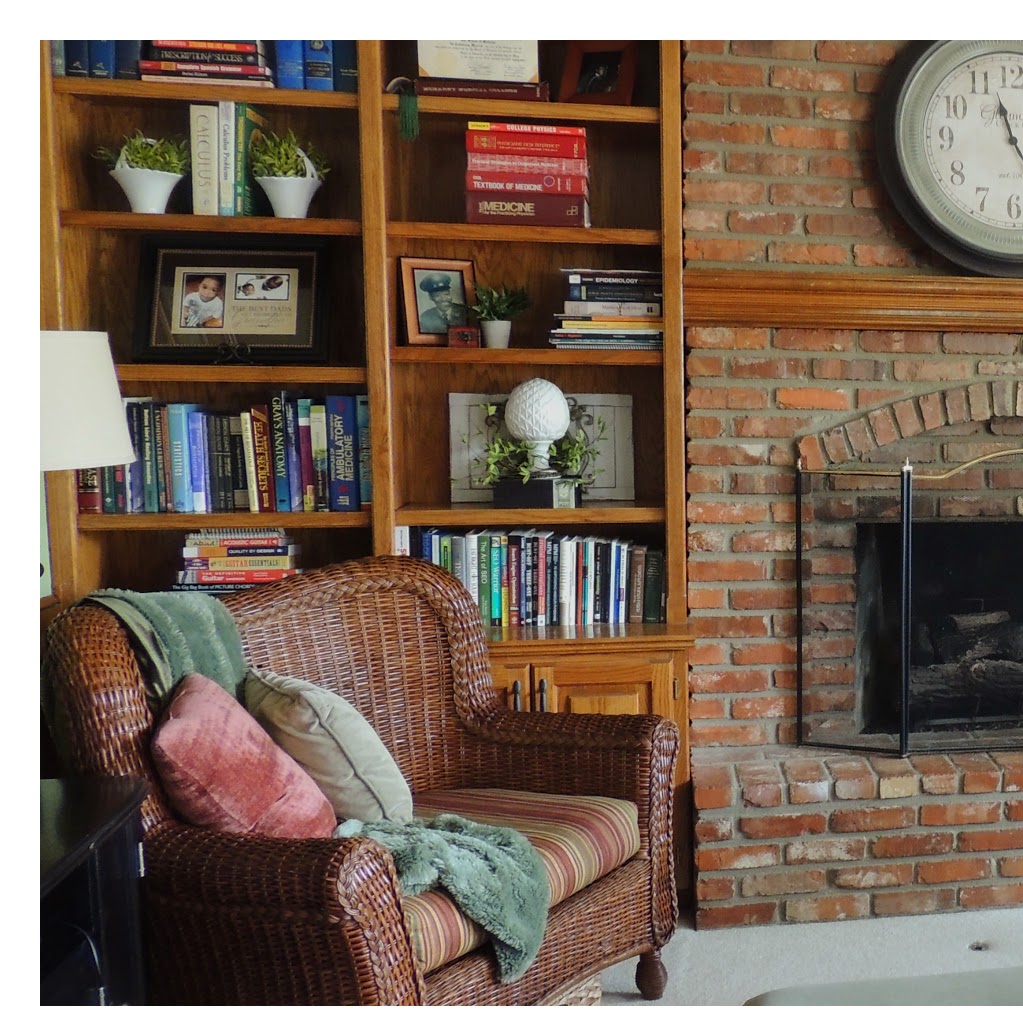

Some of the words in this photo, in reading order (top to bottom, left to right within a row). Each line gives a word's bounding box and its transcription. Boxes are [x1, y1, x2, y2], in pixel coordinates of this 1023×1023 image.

[213, 54, 243, 62] SUCCESS
[968, 70, 989, 94] 11
[1000, 65, 1023, 89] 12
[944, 94, 967, 120] 10
[506, 124, 532, 132] COLLEGE
[532, 125, 557, 133] PHYSICS
[938, 126, 954, 151] 9
[197, 114, 211, 188] CALCULUS
[223, 152, 231, 181] Problems
[950, 160, 966, 186] 8
[473, 181, 505, 190] TEXTBOOK
[516, 184, 542, 192] MEDICINE
[975, 187, 990, 212] 7
[484, 201, 535, 213] MEDICINE
[1006, 194, 1022, 220] 6
[272, 397, 282, 428] GRAY'S
[174, 441, 182, 476] STATISTICS
[274, 429, 286, 478] ANATOMY
[334, 414, 344, 480] AMBULATORY
[344, 434, 354, 481] MEDICINE
[257, 454, 268, 490] SECRETS
[492, 550, 500, 566] SEO
